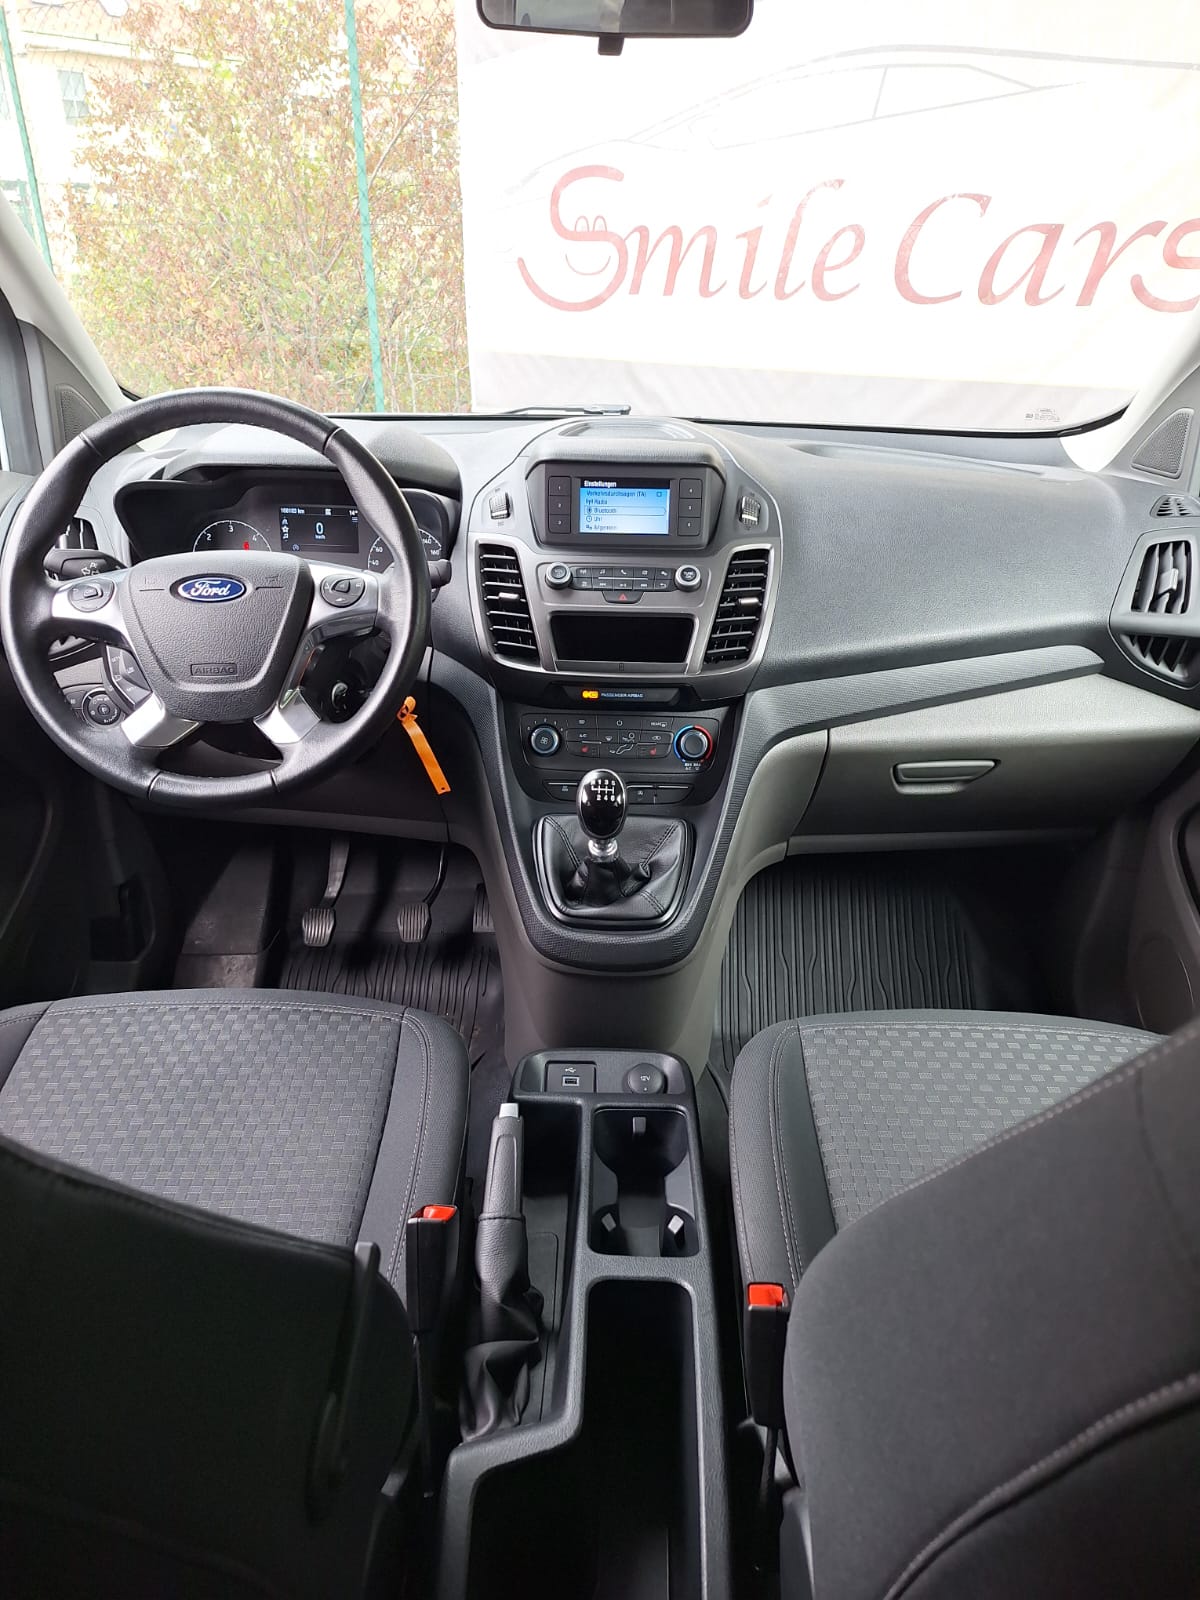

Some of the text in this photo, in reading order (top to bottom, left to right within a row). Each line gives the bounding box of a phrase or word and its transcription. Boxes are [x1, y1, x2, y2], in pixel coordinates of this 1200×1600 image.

[517, 164, 1200, 314] Smile Cars
[228, 524, 234, 533] 3
[315, 521, 324, 535] 0
[206, 533, 212, 541] 2
[190, 580, 231, 596] Ford
[194, 666, 235, 676] AIRBAG
